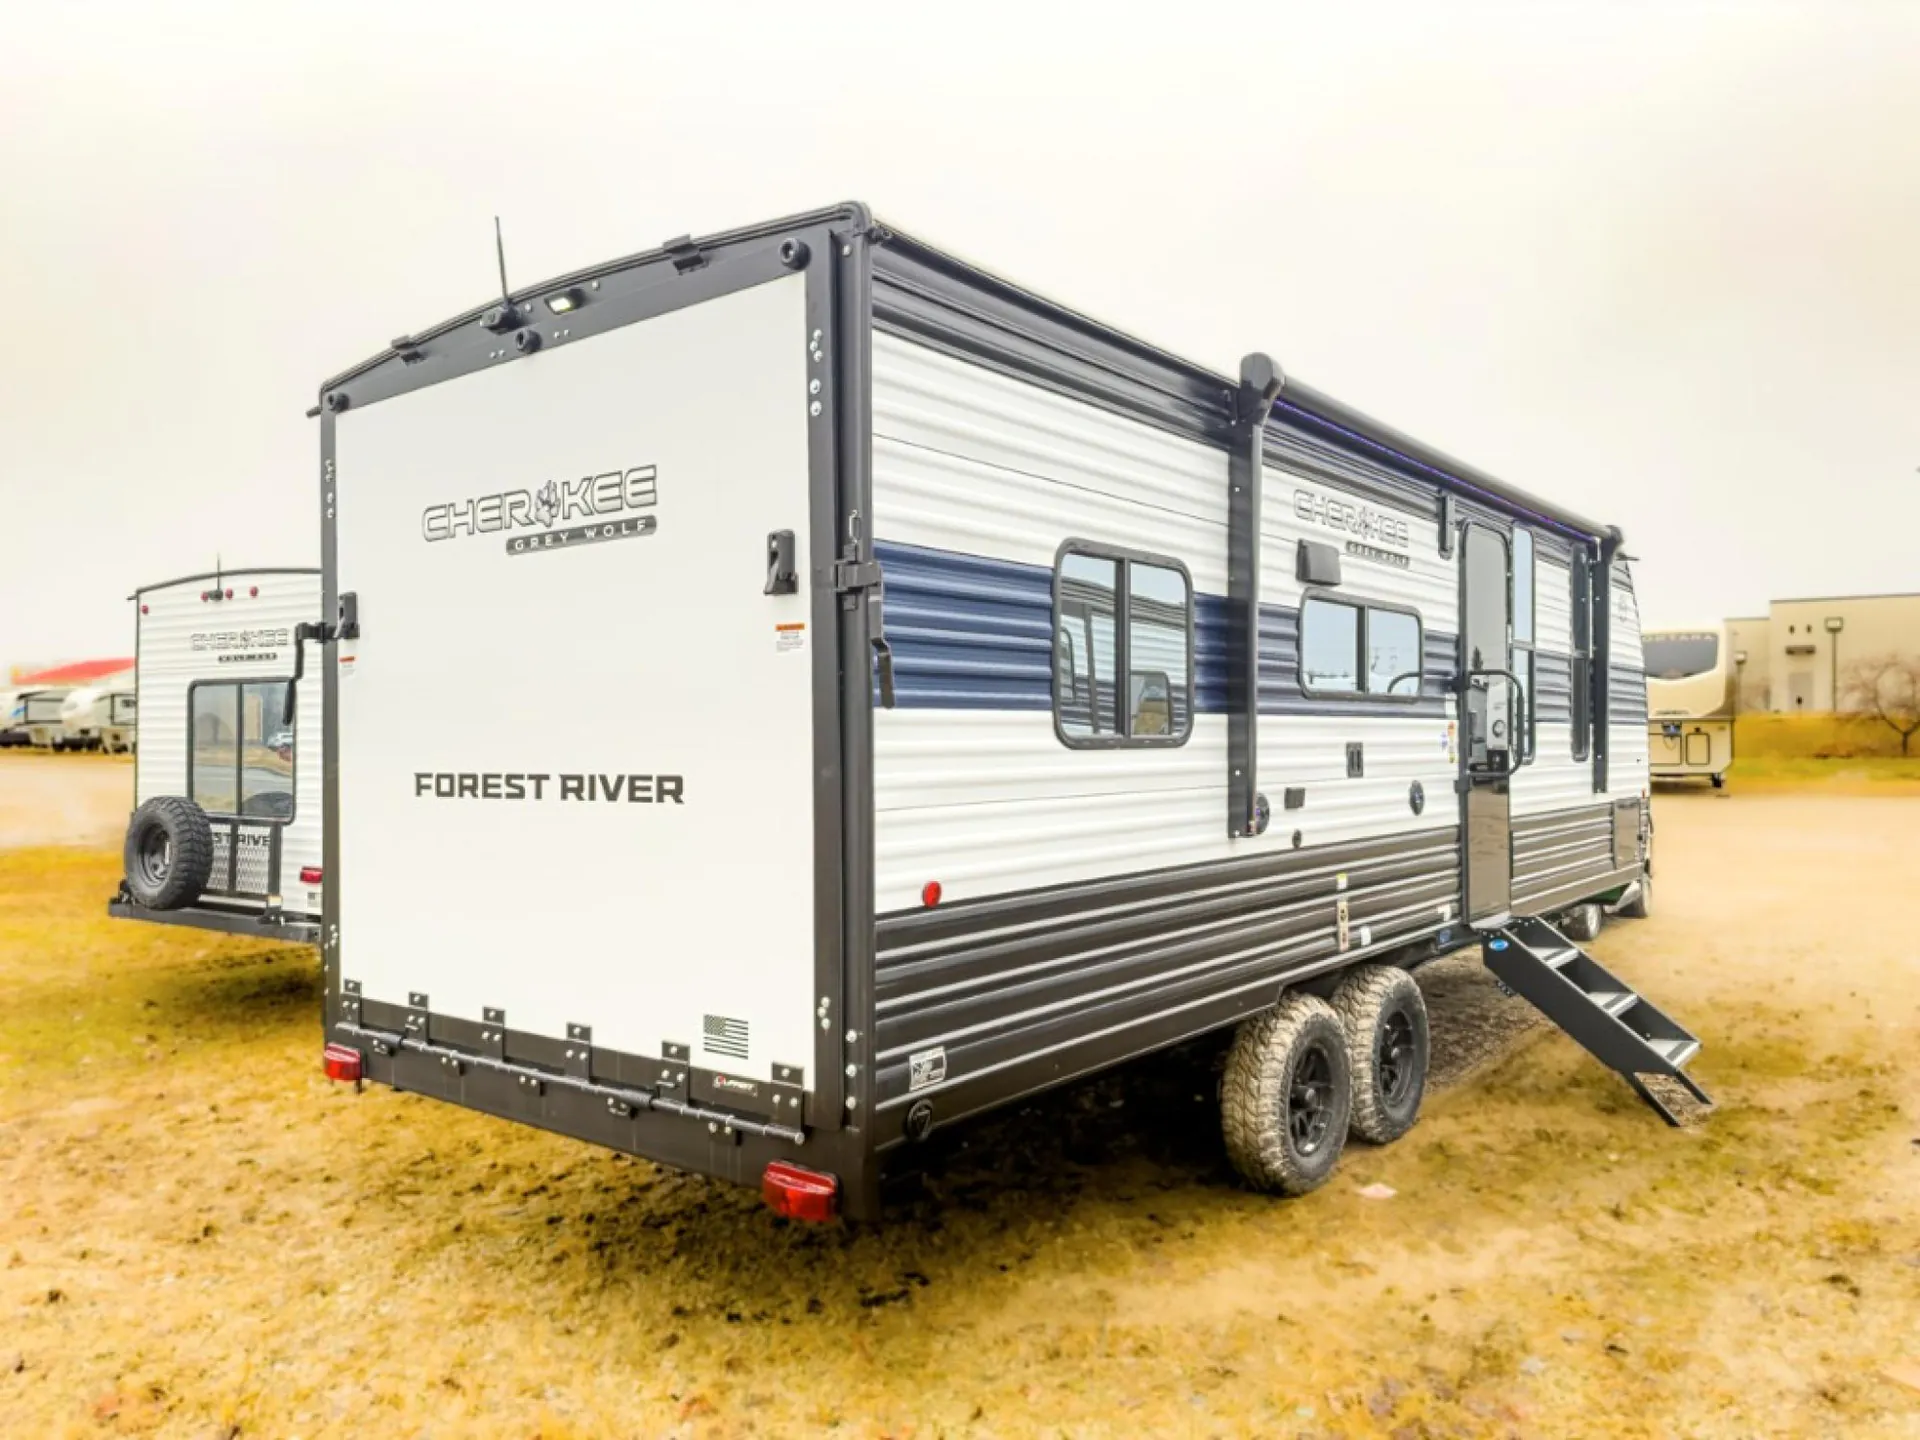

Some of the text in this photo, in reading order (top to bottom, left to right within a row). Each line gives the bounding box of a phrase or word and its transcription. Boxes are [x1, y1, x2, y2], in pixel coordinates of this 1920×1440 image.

[422, 464, 658, 542] CHEROKEE
[515, 519, 647, 551] GREY WOLF
[414, 772, 685, 805] FOREST RIVER
